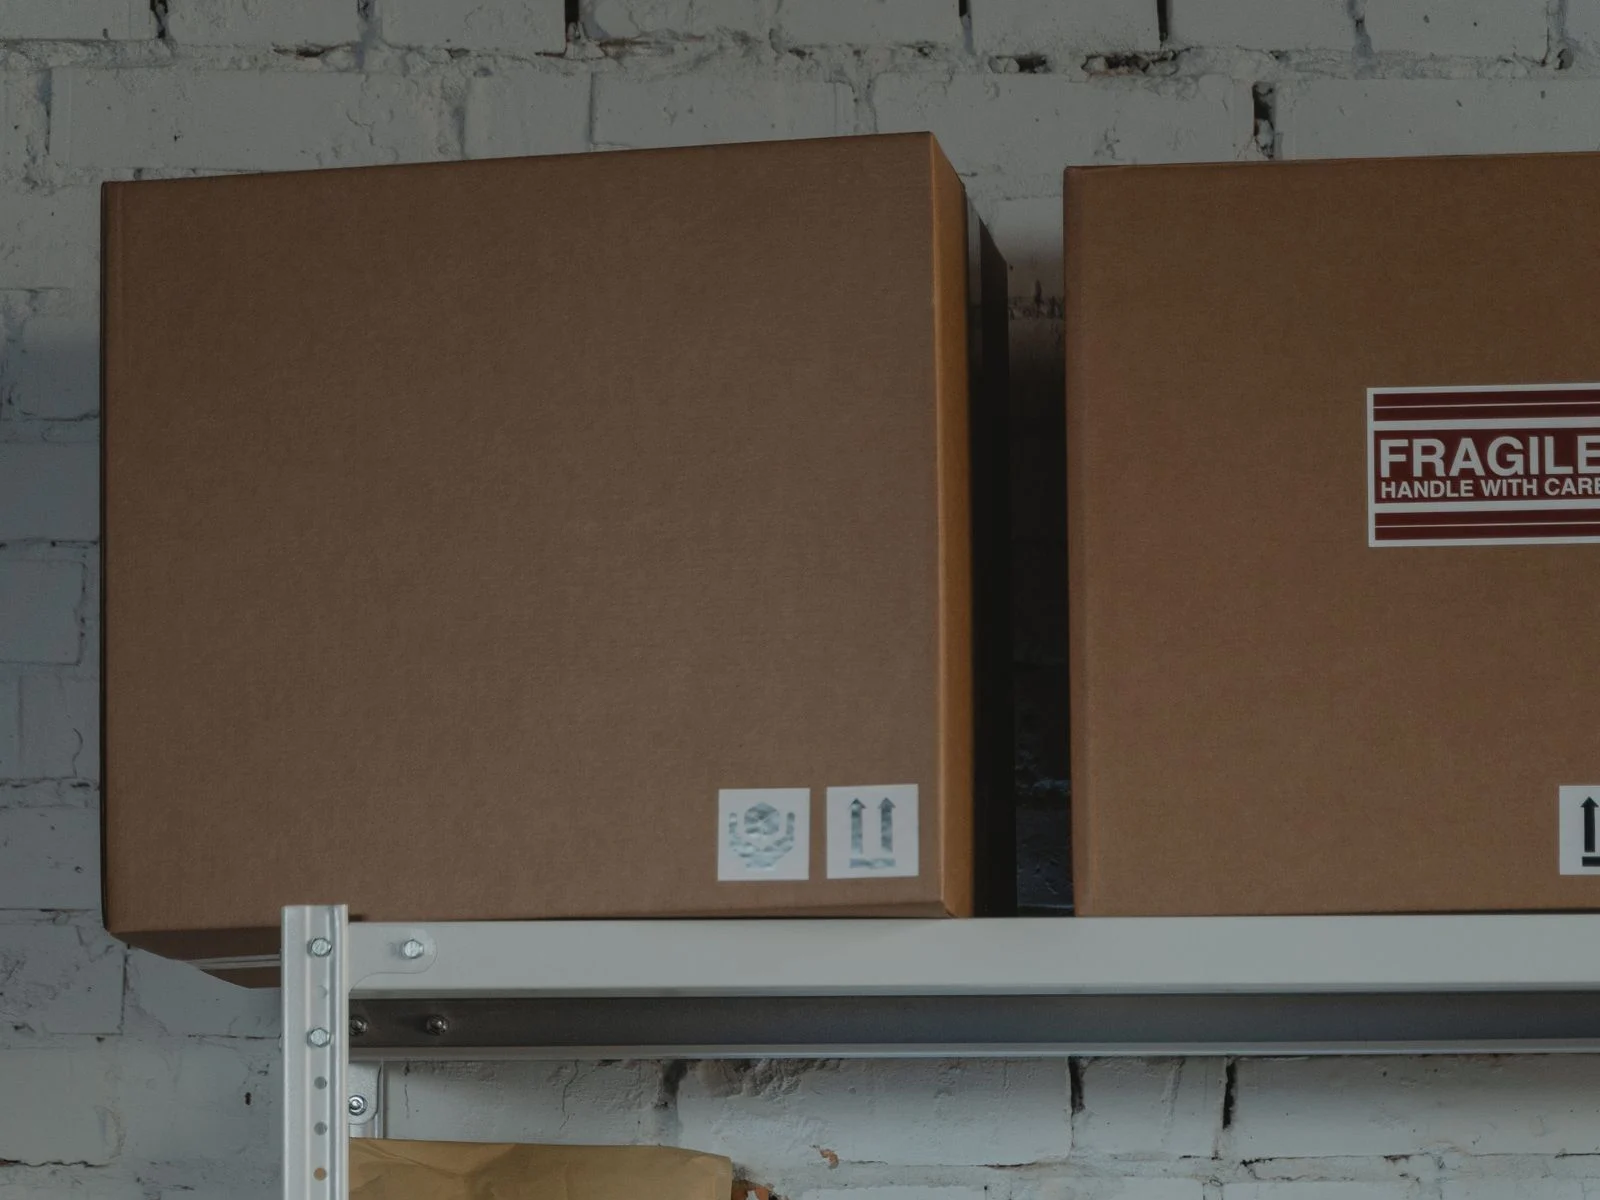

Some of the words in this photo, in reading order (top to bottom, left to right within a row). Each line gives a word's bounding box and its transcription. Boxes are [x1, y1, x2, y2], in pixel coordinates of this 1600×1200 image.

[1380, 436, 1600, 477] FRAGILE
[1381, 480, 1474, 498] HANDLE
[1480, 478, 1537, 496] WITH
